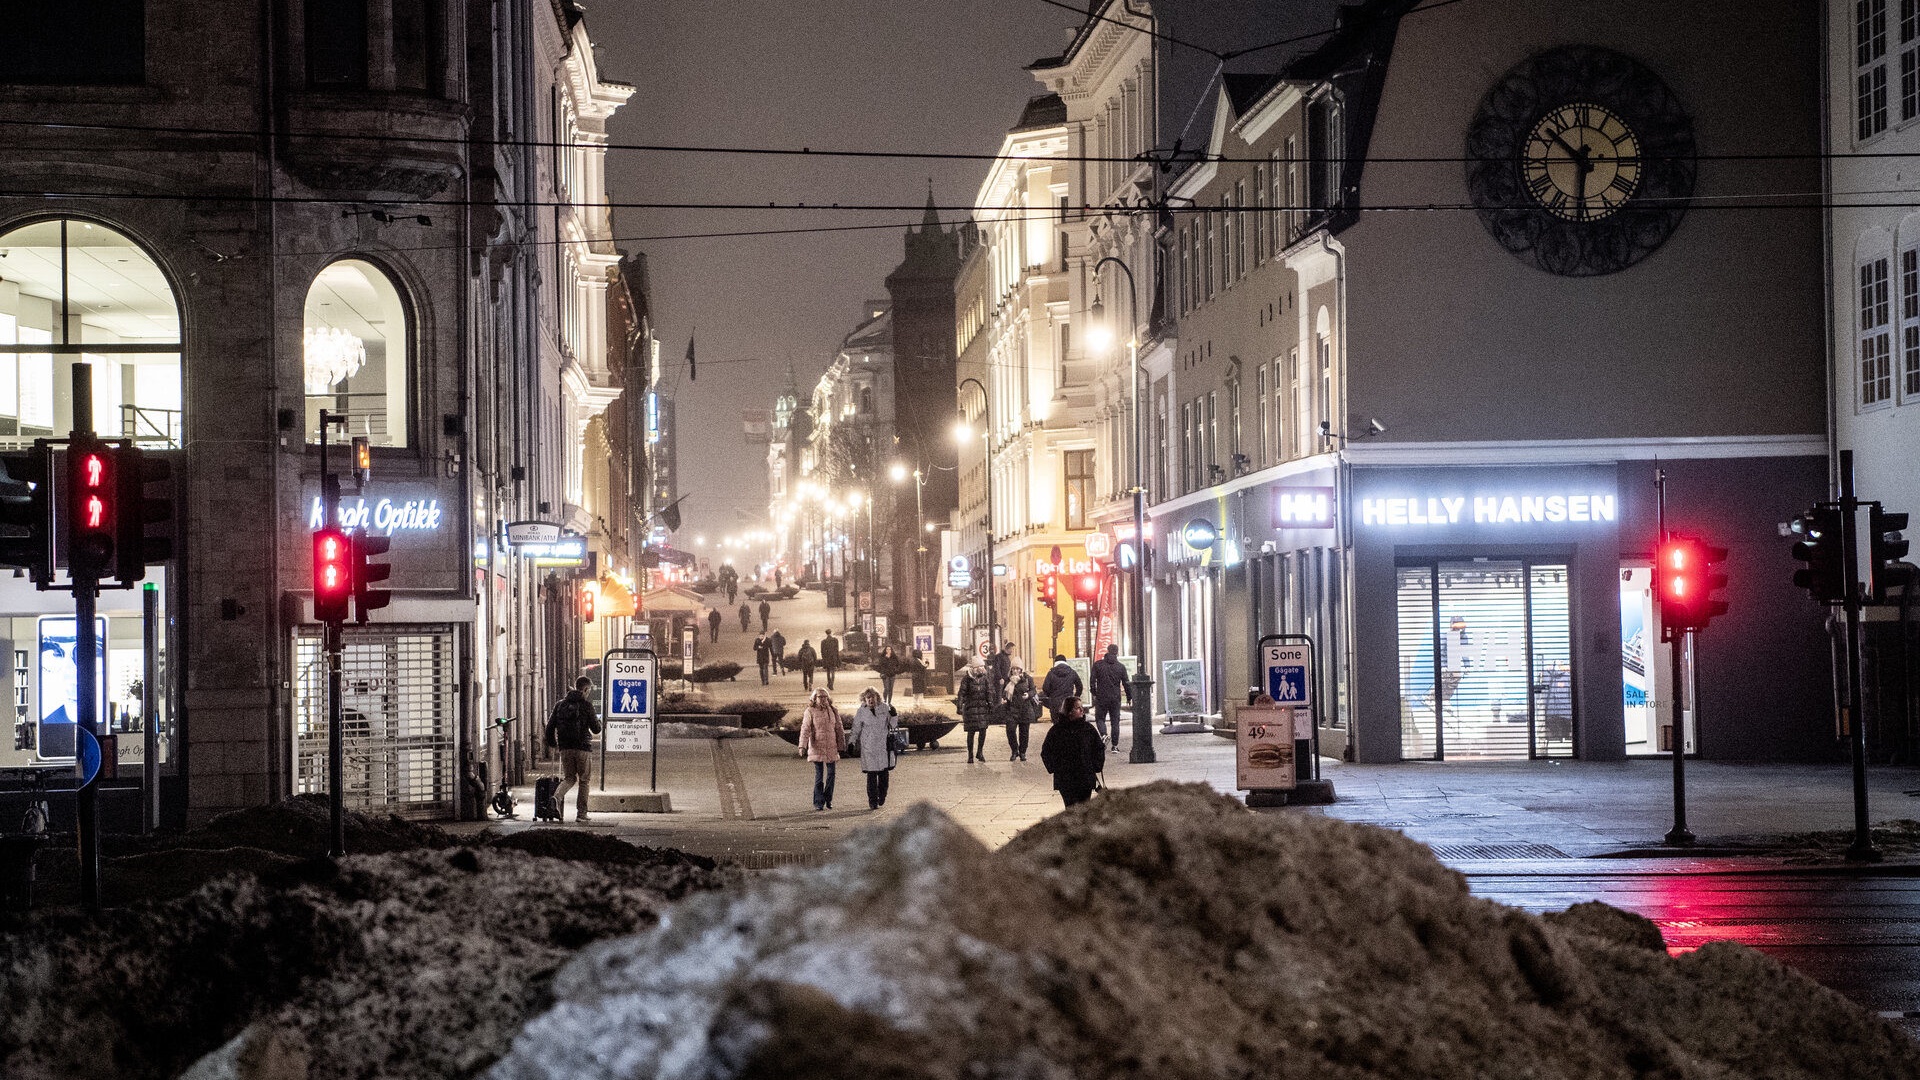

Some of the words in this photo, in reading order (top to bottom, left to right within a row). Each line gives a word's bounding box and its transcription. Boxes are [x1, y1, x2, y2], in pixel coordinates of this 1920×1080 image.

[1362, 498, 1465, 525] HELLY
[1473, 496, 1615, 522] HANSEN
[375, 499, 440, 537] Optikk
[1271, 650, 1302, 660] Sone
[615, 663, 645, 673] Sone
[1274, 667, 1299, 675] Gågate
[1248, 726, 1265, 739] 49
